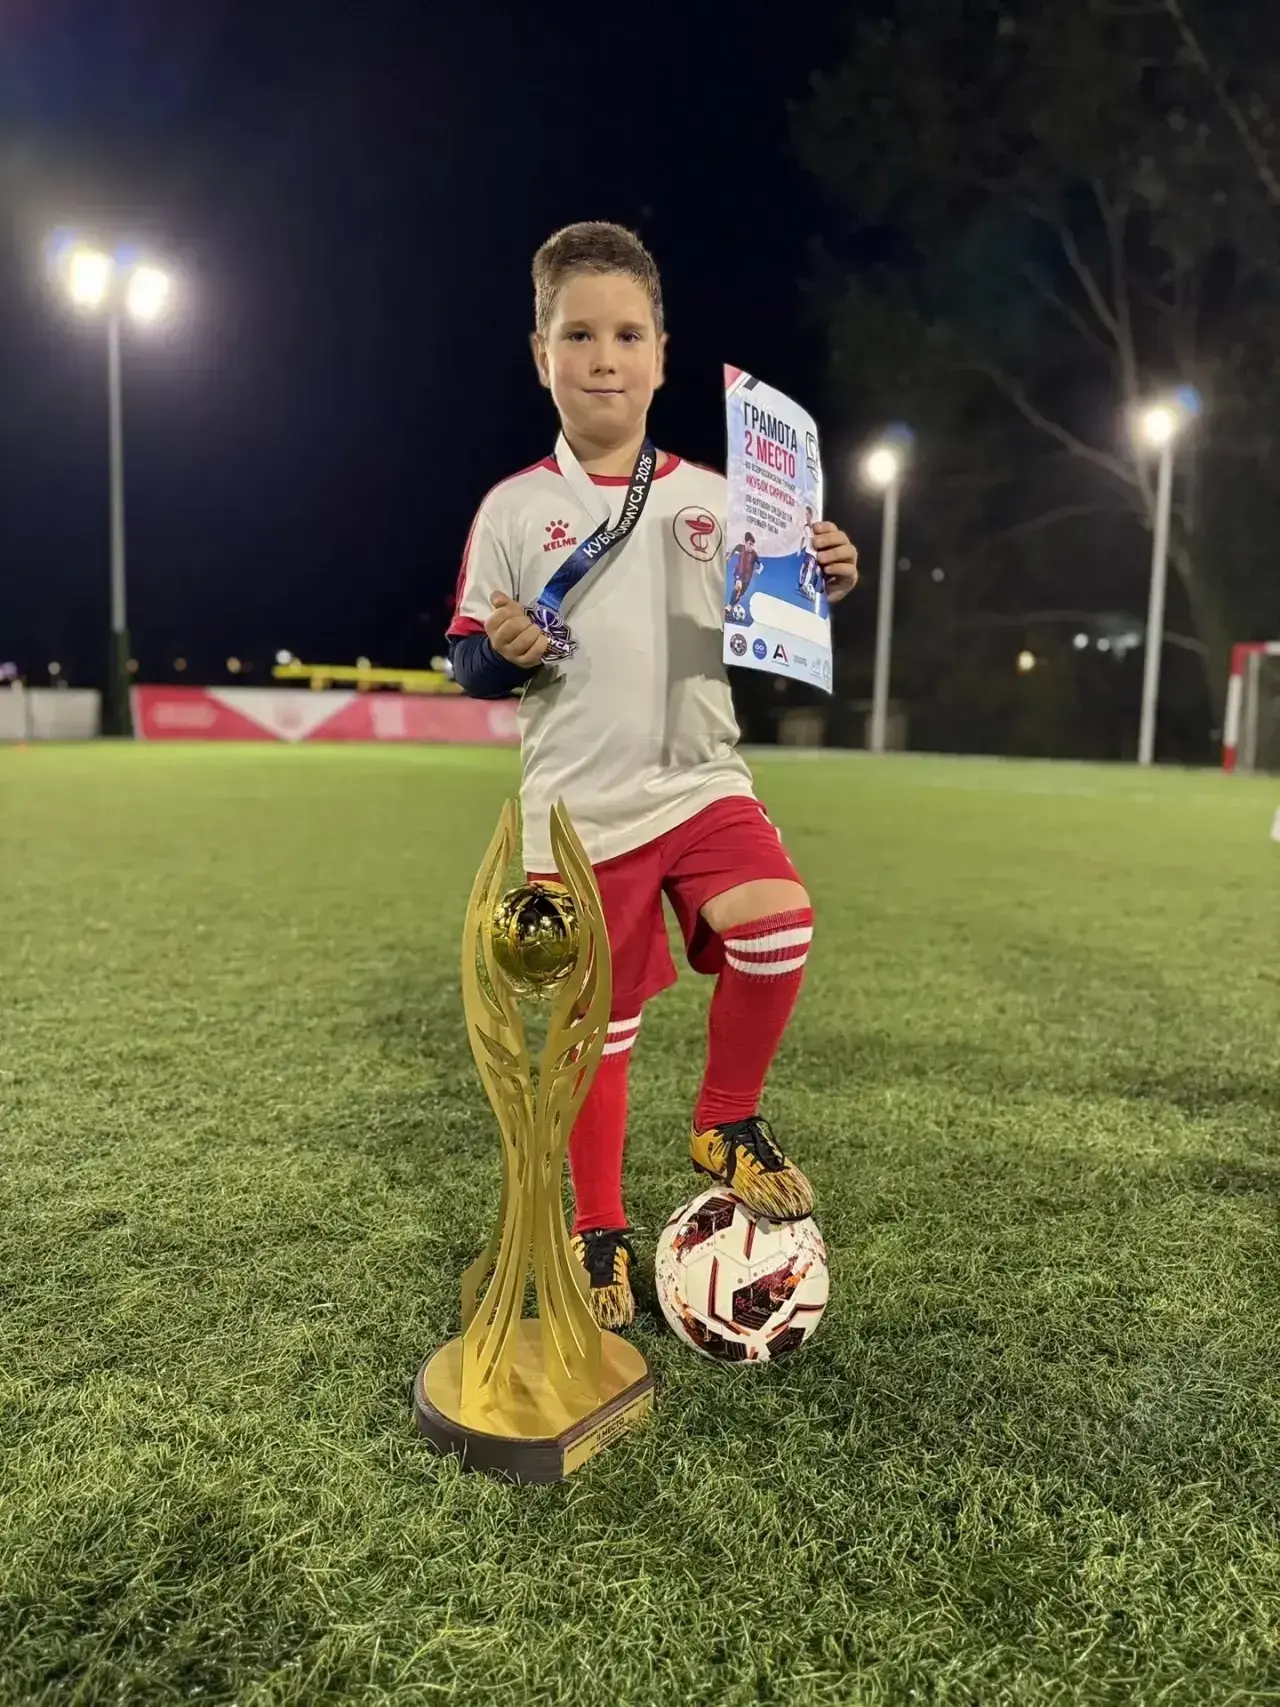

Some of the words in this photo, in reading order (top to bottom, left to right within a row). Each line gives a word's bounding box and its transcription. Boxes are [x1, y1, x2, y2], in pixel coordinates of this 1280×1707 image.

[744, 401, 798, 454] ГРАМОТА
[745, 430, 753, 457] 2
[757, 435, 796, 479] МЕСТО
[583, 530, 617, 559] КУБО
[636, 454, 653, 483] 2026
[543, 537, 577, 552] KELME
[602, 1417, 625, 1438] МЕСТО
